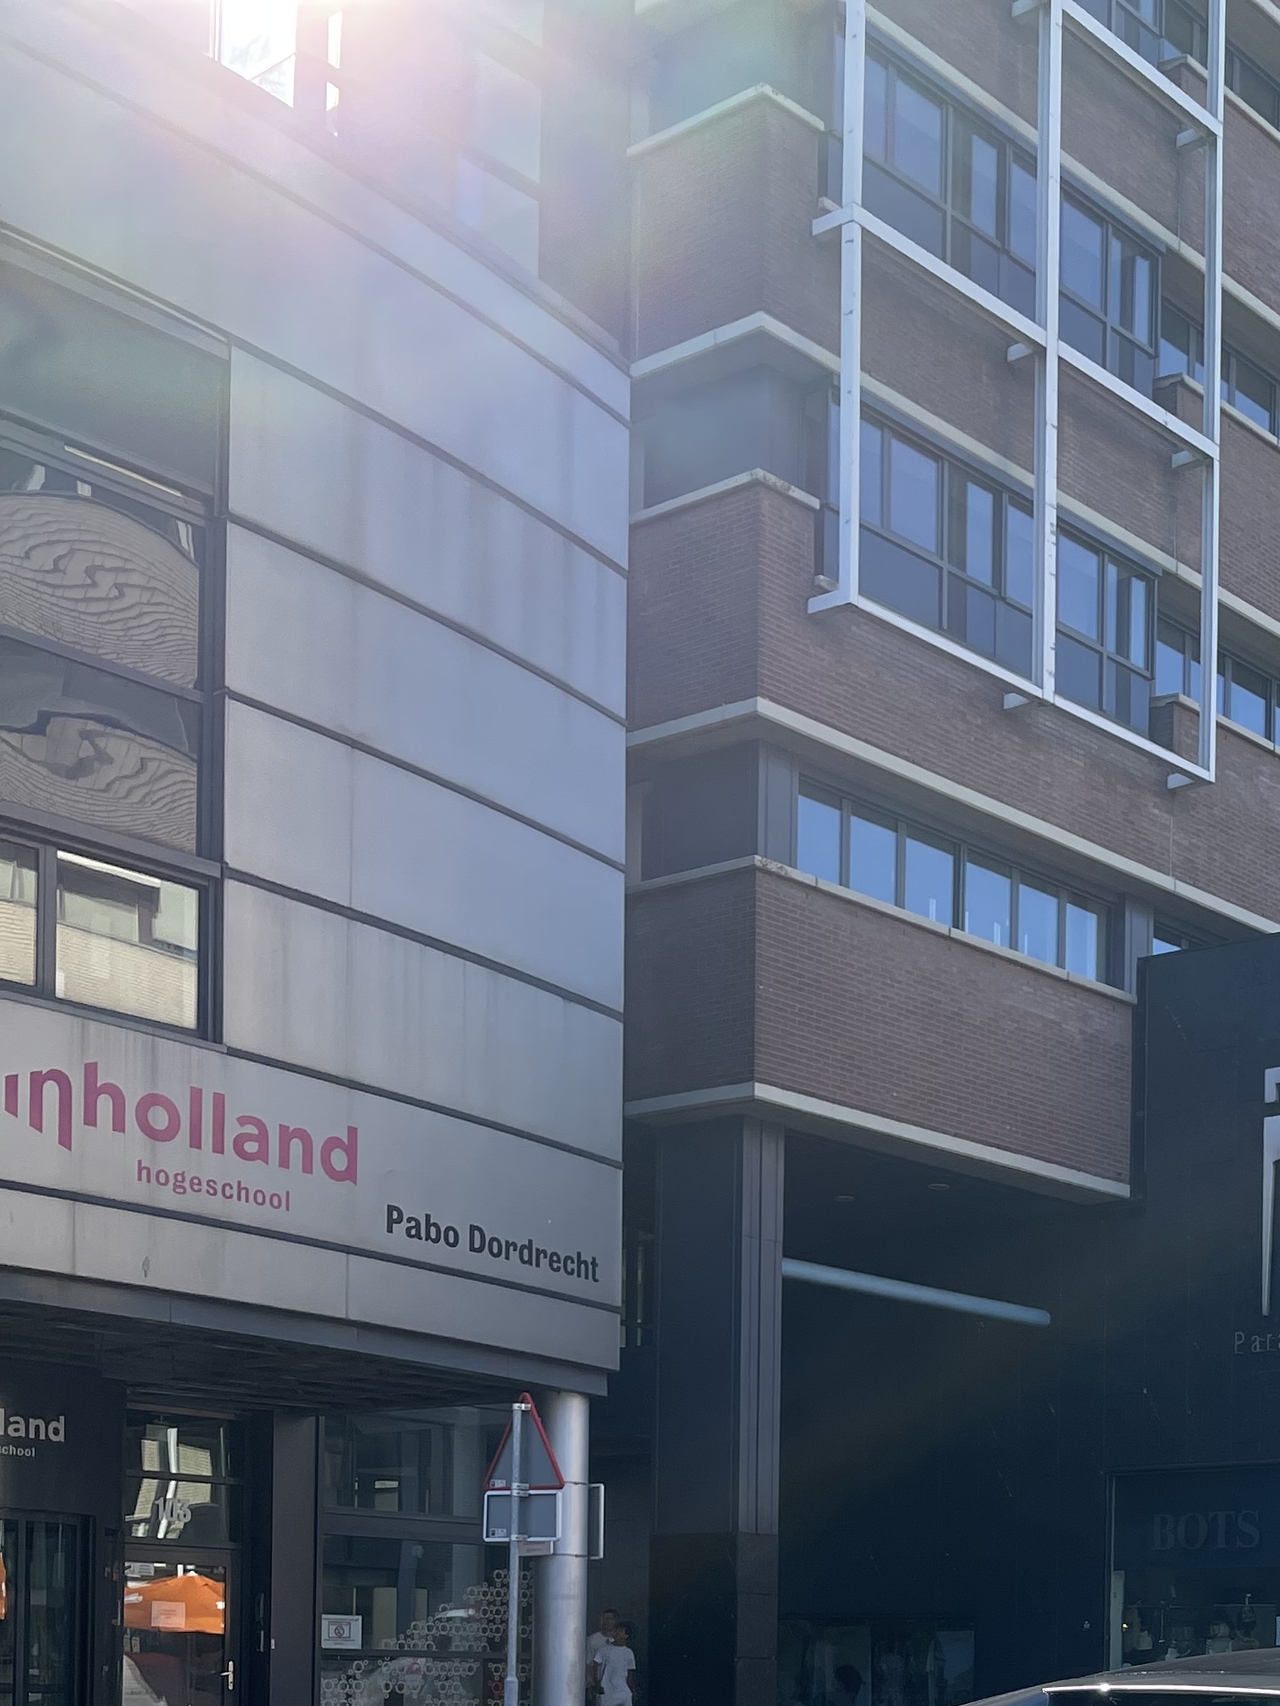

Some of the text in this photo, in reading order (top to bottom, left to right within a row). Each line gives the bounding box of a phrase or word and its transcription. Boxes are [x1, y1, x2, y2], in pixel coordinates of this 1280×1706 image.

[137, 1160, 290, 1211] hogeschool
[386, 1204, 599, 1282] Pabo Dordrecht
[0, 1444, 35, 1457] chool
[155, 1497, 192, 1522] 103
[1151, 1510, 1260, 1550] BOTS
